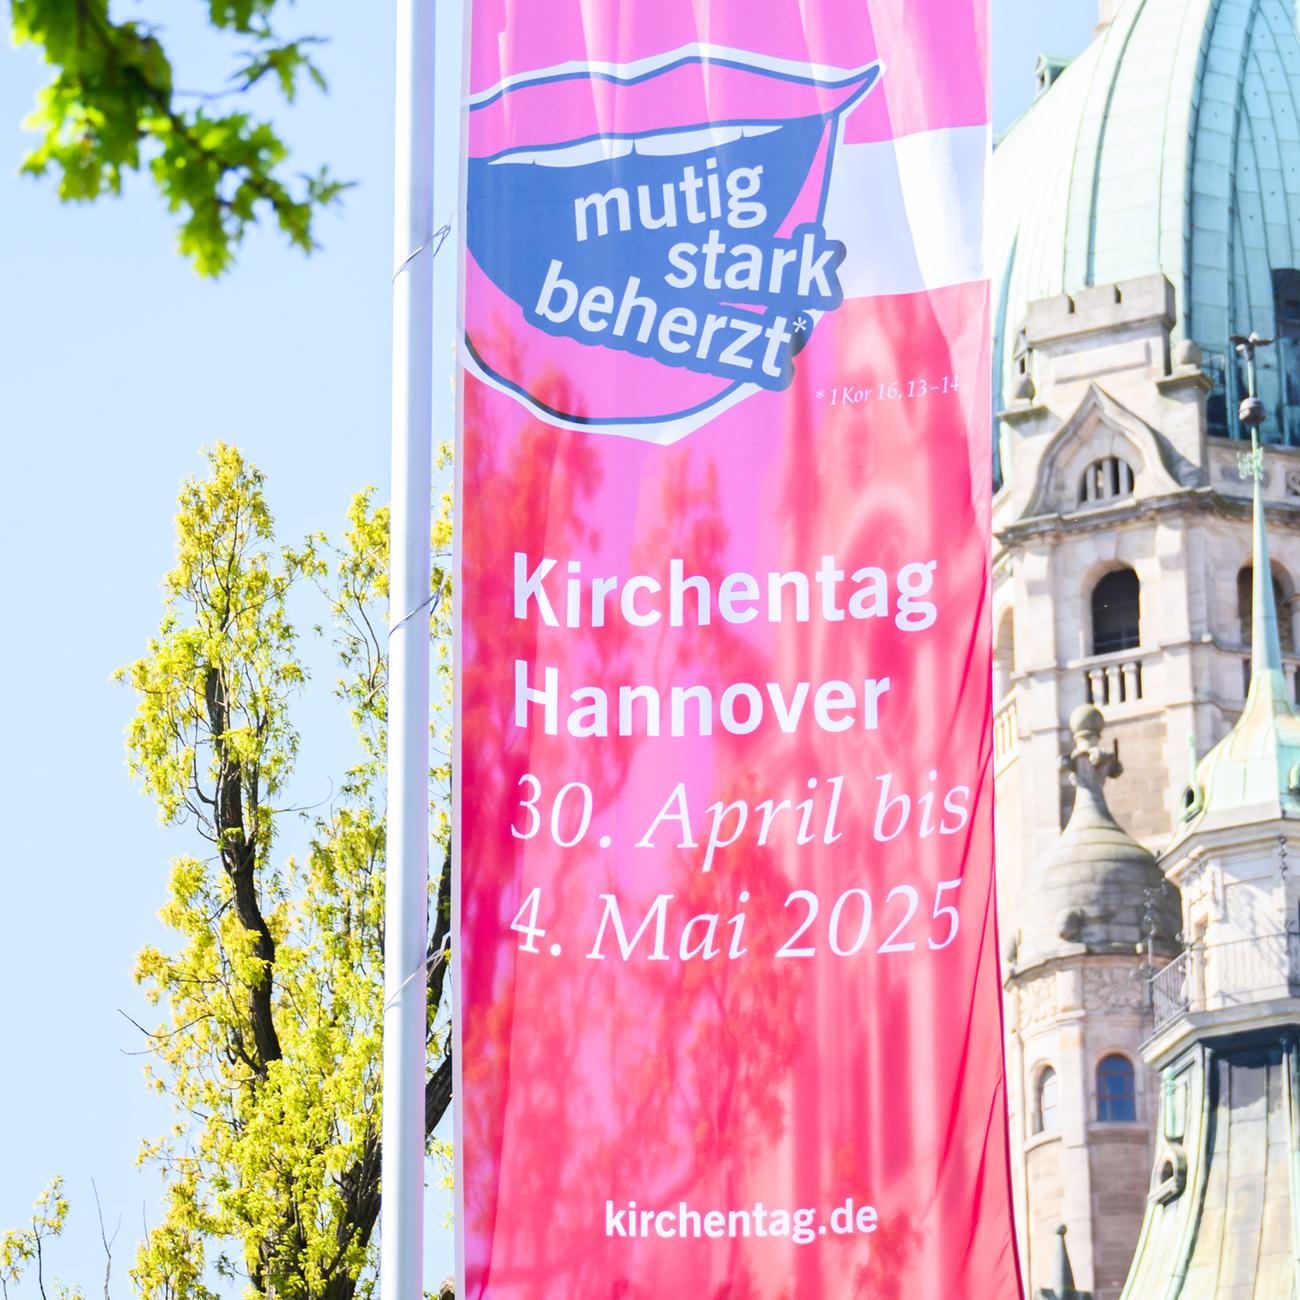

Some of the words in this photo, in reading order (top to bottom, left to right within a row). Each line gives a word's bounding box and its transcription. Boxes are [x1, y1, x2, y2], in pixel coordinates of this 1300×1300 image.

[574, 157, 767, 242] mutig
[664, 229, 836, 297] stark
[829, 388, 837, 405] 1
[842, 386, 872, 405] Kor
[877, 382, 902, 400] 16,
[513, 551, 937, 632] Kirchentag
[514, 658, 890, 737] Hannover
[511, 774, 611, 849] 30.
[635, 775, 843, 872] April
[873, 769, 970, 842] bis
[510, 887, 561, 956] 4.
[586, 891, 750, 960] Mai
[775, 878, 962, 957] 2025
[605, 1198, 878, 1245] kirchentag.de
